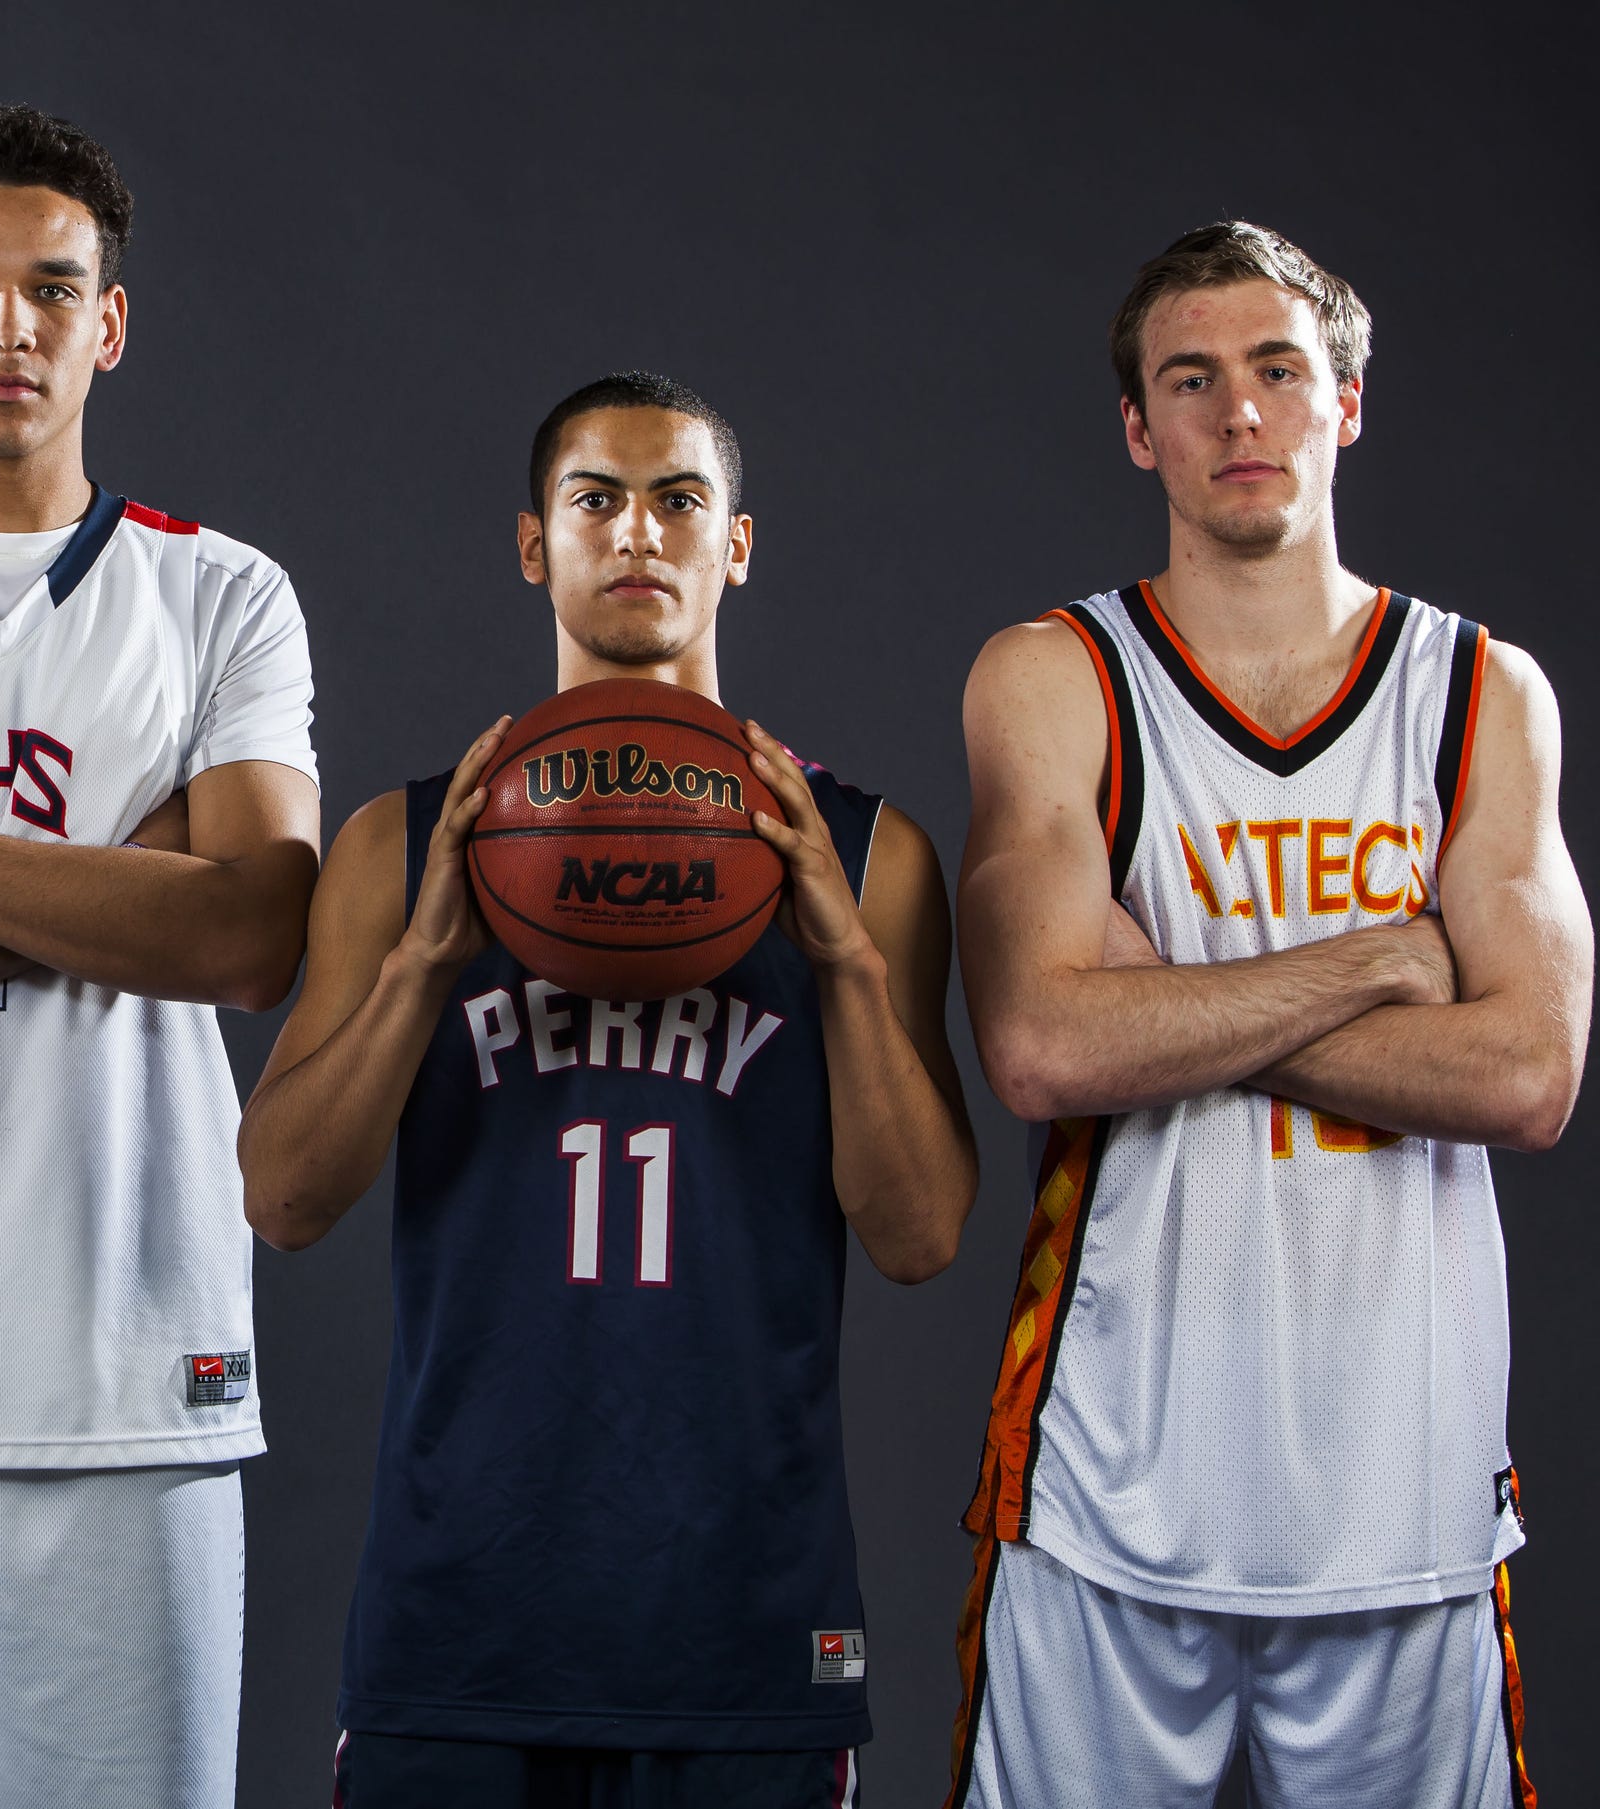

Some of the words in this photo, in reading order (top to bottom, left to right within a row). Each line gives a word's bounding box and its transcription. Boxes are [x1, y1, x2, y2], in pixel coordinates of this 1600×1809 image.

[522, 743, 745, 814] Wilson
[556, 855, 717, 907] NCAA
[463, 978, 787, 1098] PERRY
[557, 1117, 676, 1288] 11
[226, 1360, 249, 1377] XXL
[852, 1638, 860, 1655] L
